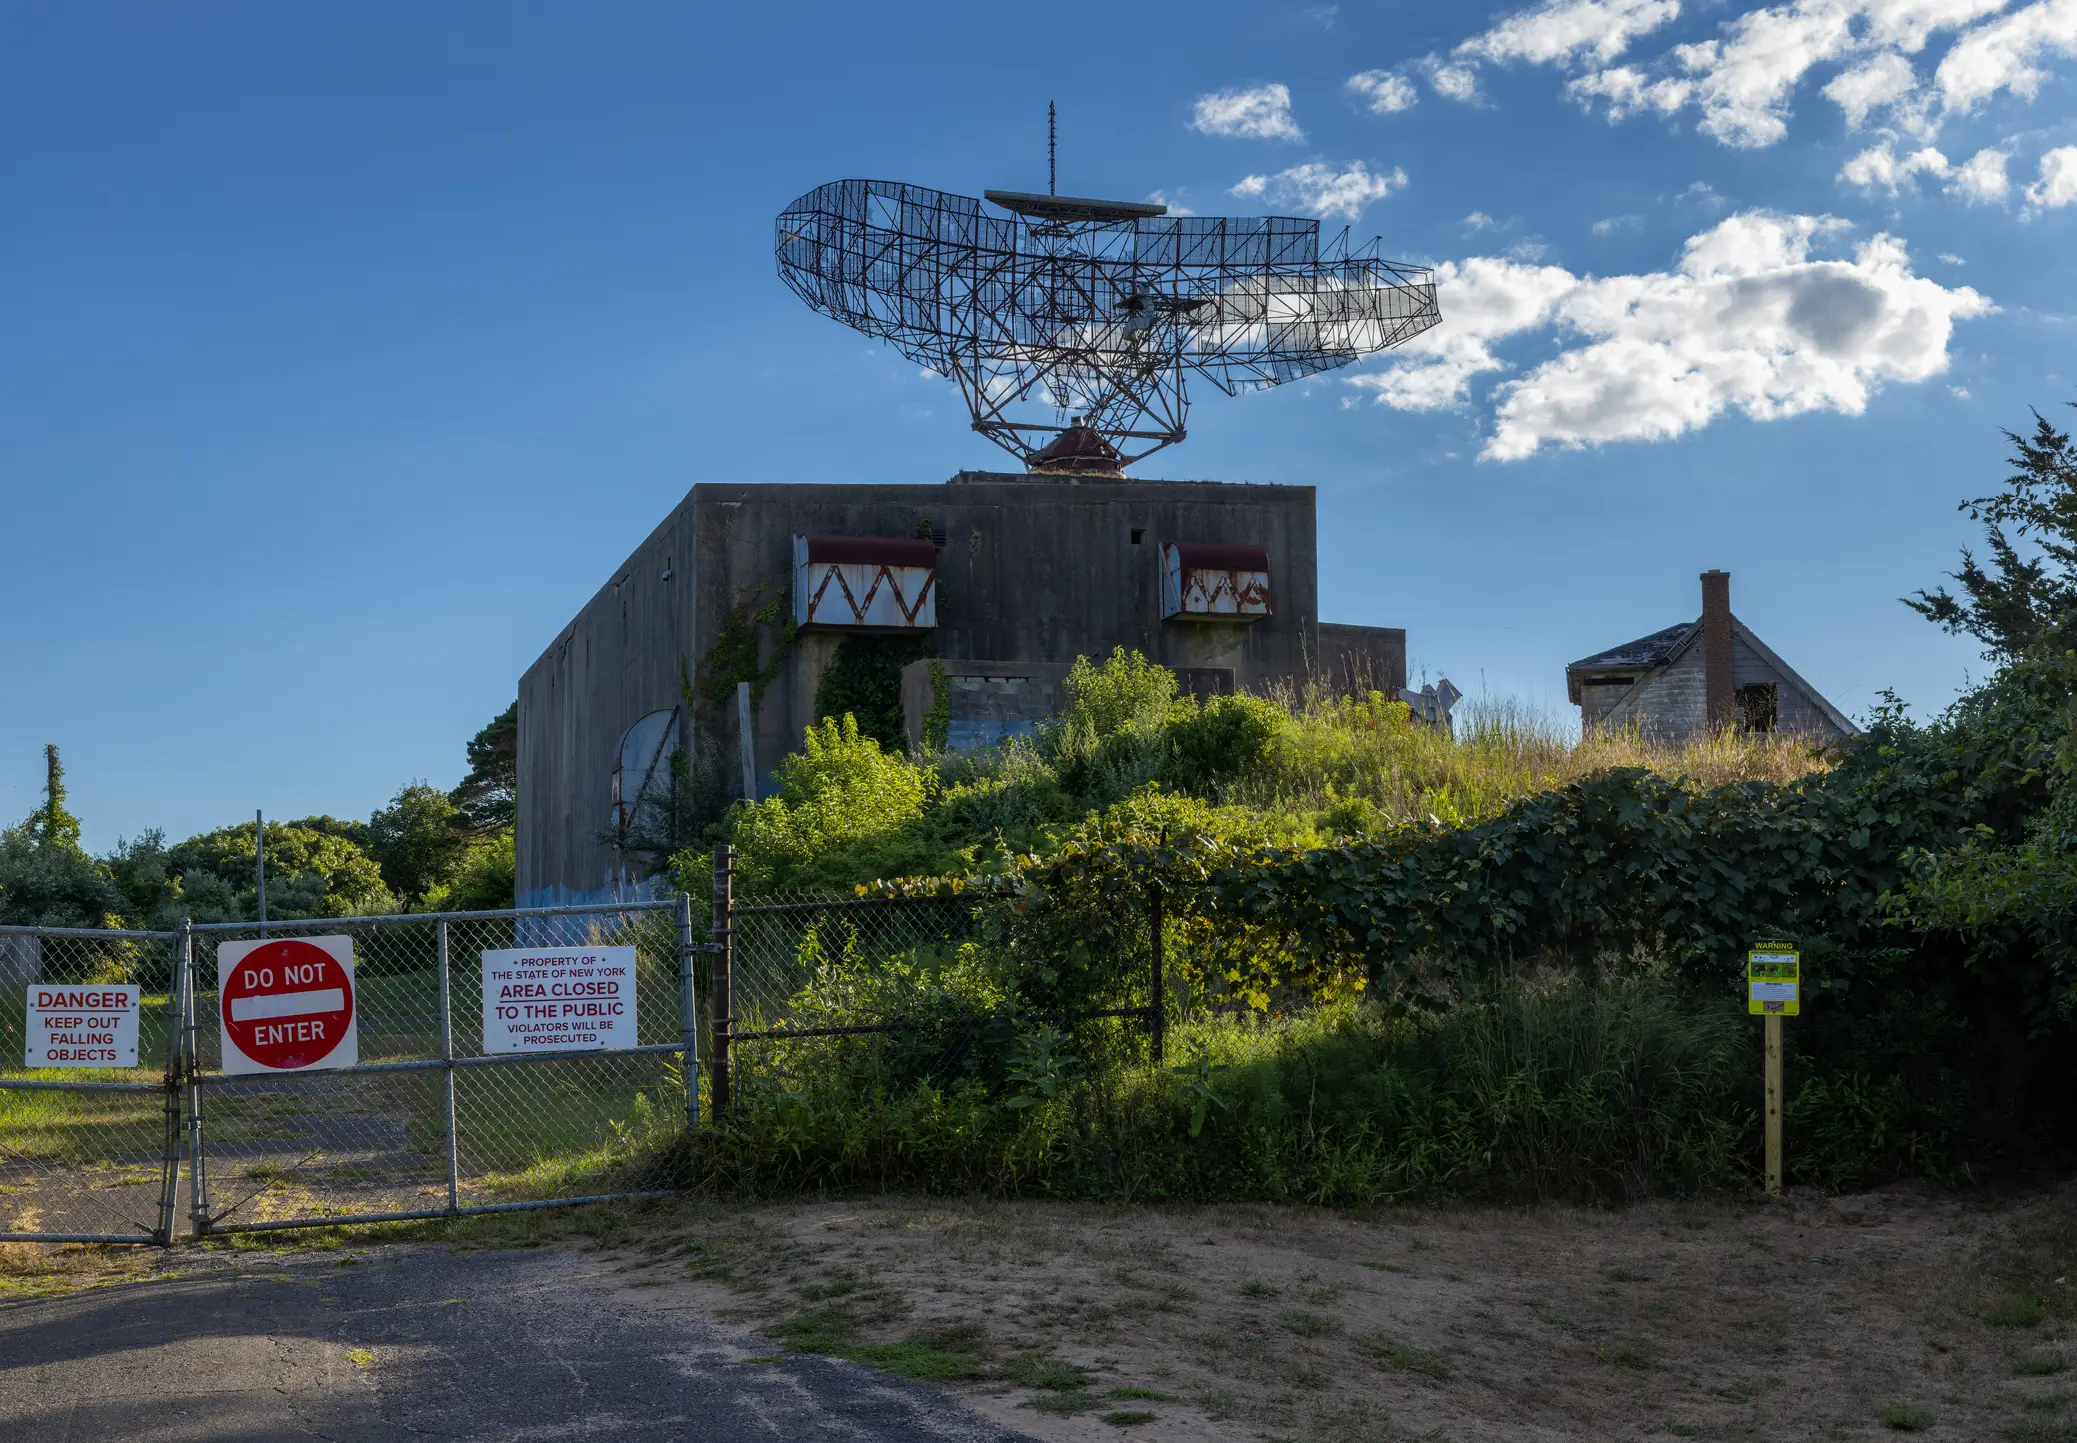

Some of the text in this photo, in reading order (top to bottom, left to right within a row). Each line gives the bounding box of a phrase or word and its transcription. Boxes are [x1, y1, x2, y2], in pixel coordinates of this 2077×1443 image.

[521, 956, 597, 967] PROPERTY OF
[244, 963, 326, 990] DO NOT
[491, 967, 626, 980] THE STATE OF NEW YORK
[500, 981, 619, 998] AREA CLOSED
[38, 992, 128, 1008] DANGER
[495, 1002, 624, 1020] TO THE PUBLIC
[44, 1017, 121, 1029] KEEP OUT
[507, 1021, 613, 1033] VIOLATORS WILL BE
[50, 1033, 114, 1045] FALLING
[254, 1021, 325, 1046] ENTER
[523, 1033, 597, 1045] PROSECUTED
[47, 1049, 117, 1061] OBJECTS
